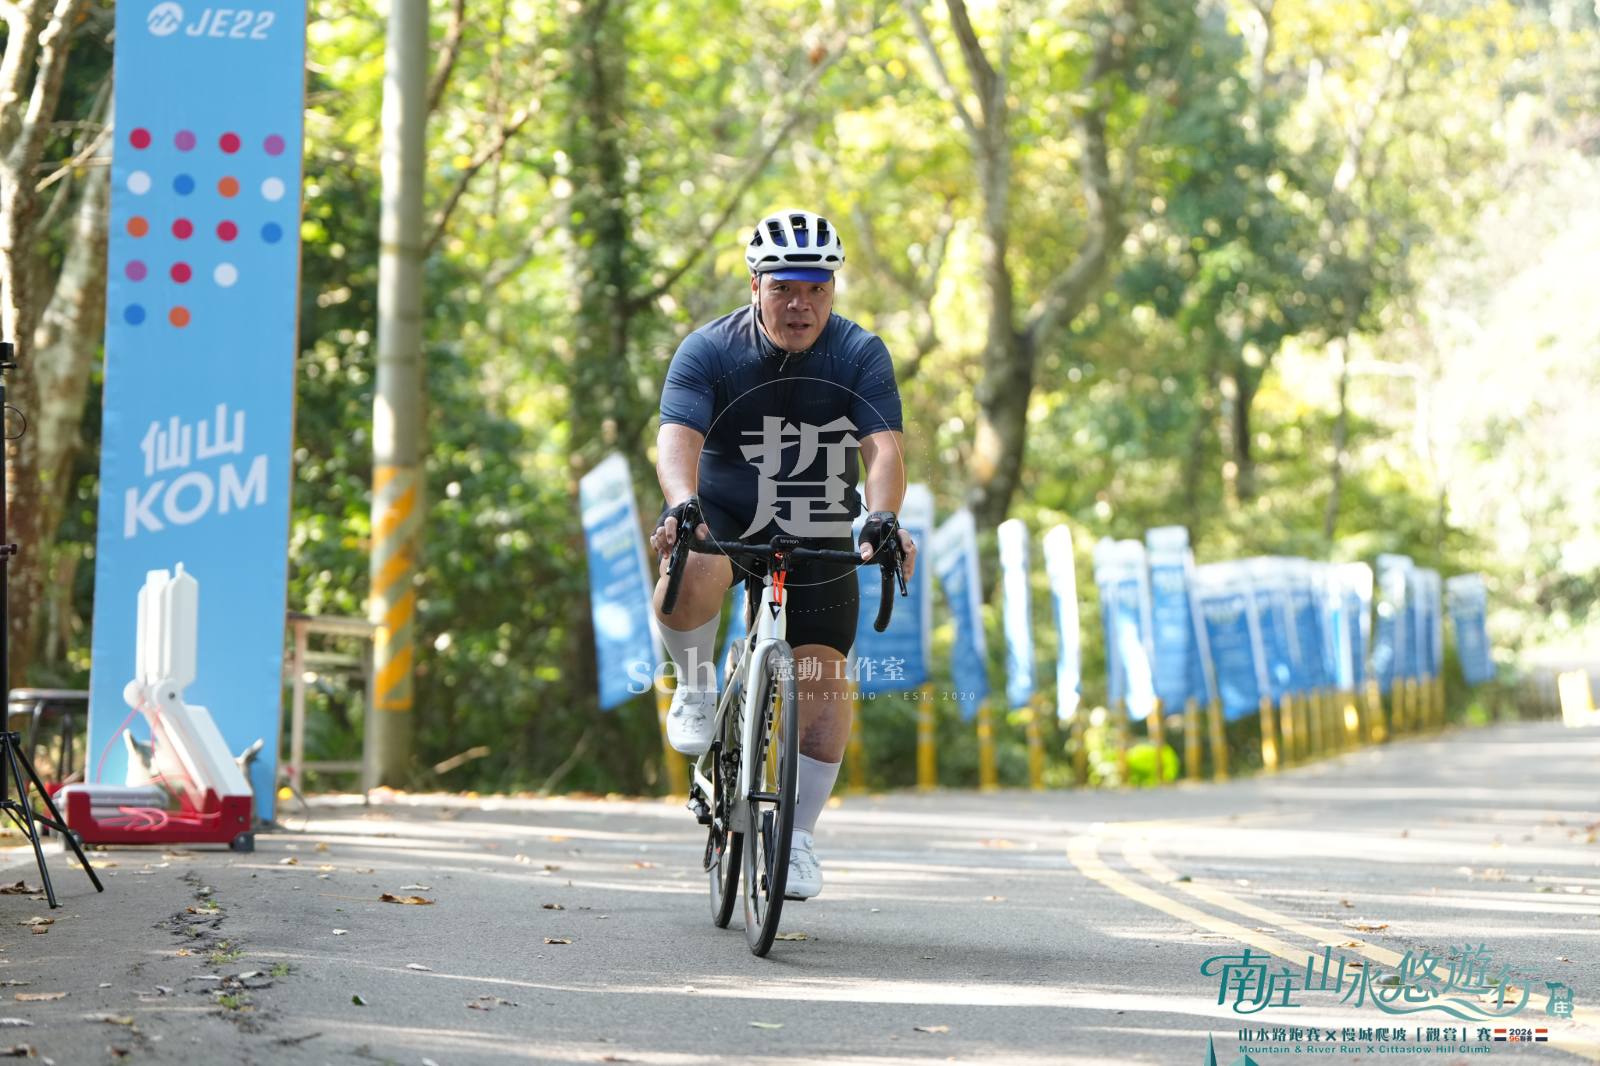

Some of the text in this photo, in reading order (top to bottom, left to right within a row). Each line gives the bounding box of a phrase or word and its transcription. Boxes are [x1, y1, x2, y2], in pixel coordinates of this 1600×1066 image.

[185, 8, 276, 40] JE22
[140, 402, 246, 478] 仙山
[123, 454, 268, 539] KOM
